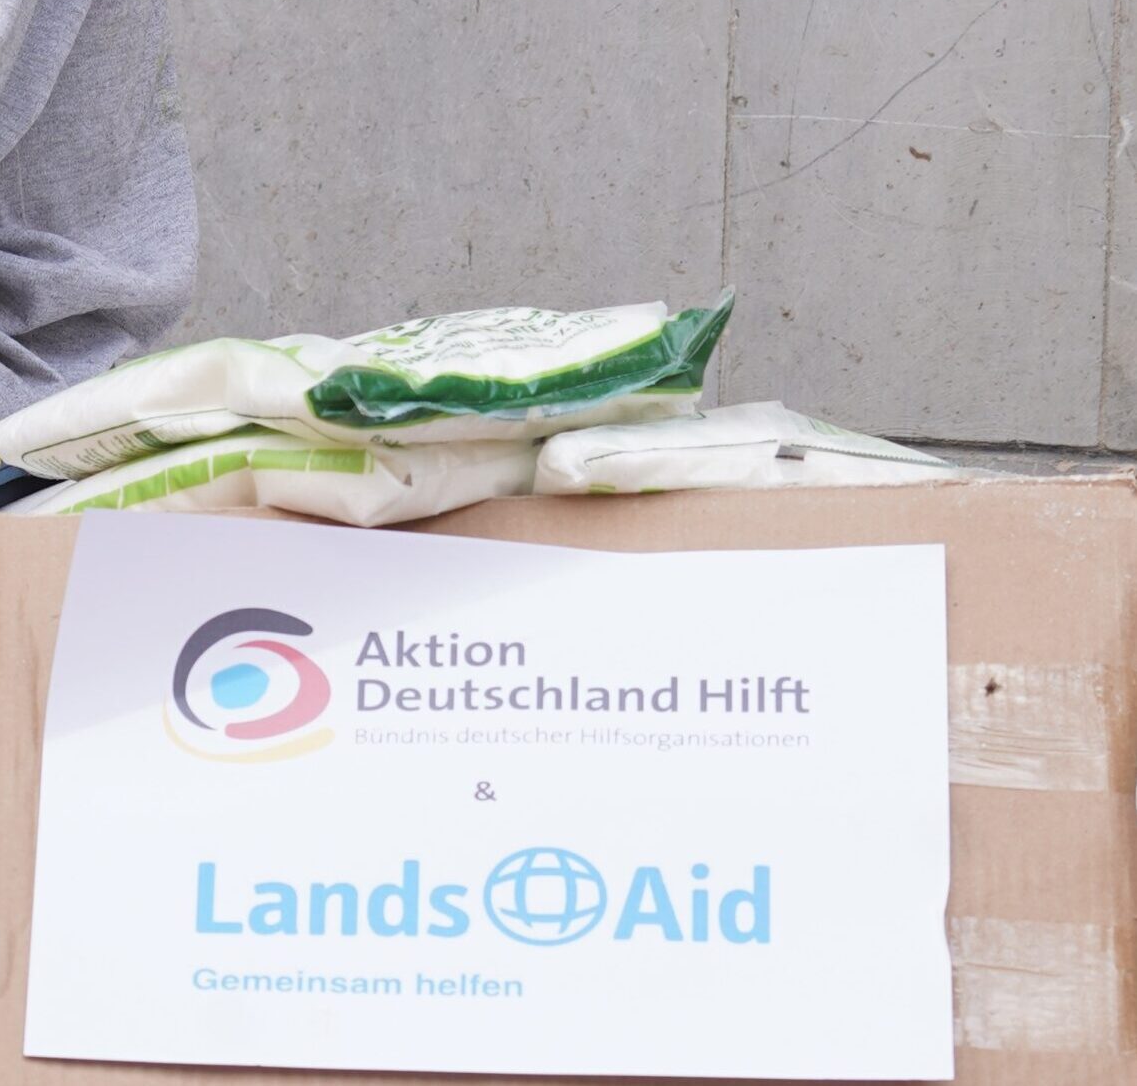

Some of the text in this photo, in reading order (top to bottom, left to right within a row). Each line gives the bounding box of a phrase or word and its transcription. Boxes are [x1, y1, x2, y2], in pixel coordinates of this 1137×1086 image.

[355, 630, 526, 667] Aktion
[356, 676, 810, 714] Deutschland Hilft
[355, 726, 810, 751] Bündnis deutscher Hilfsorganisationen
[474, 780, 498, 801] &
[195, 859, 771, 944] Lands Aid
[192, 968, 523, 997] Gemeinsam helfen
